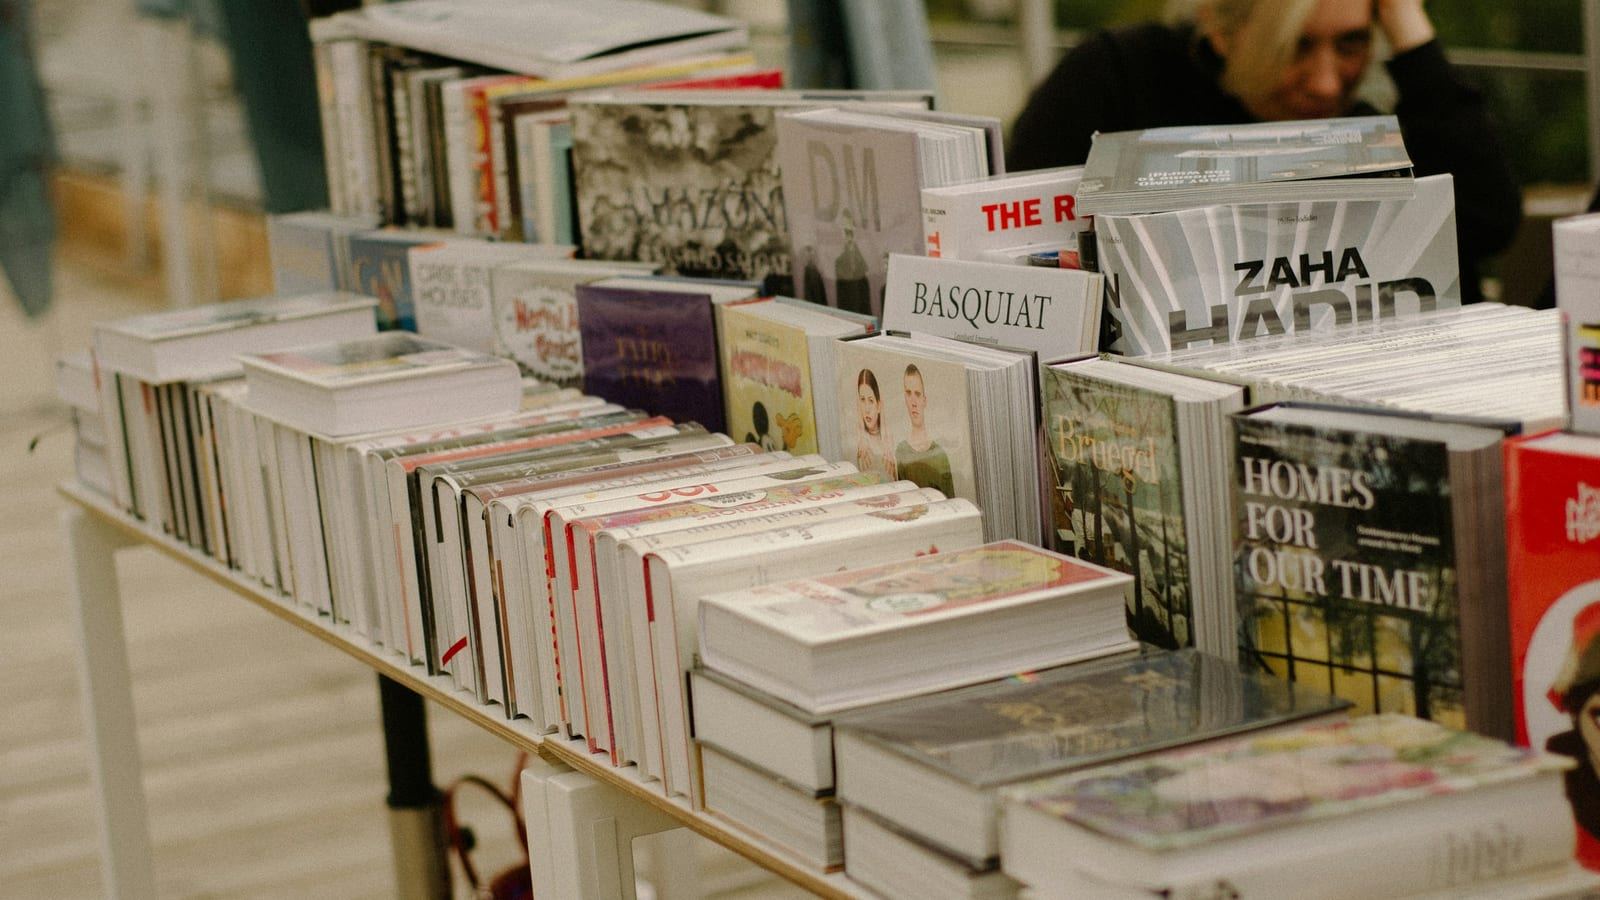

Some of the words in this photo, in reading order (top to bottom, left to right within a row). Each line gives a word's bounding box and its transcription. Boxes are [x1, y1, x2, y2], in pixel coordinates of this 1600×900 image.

[981, 198, 1042, 232] THE
[1053, 194, 1077, 223] R
[1233, 247, 1370, 297] ZAHA
[911, 282, 1052, 330] BASQUIAT
[1168, 277, 1437, 352] HADID
[1242, 456, 1375, 511] HOMES
[1246, 501, 1319, 549] FOR
[1249, 547, 1328, 597] OUR
[1332, 559, 1432, 613] TIME
